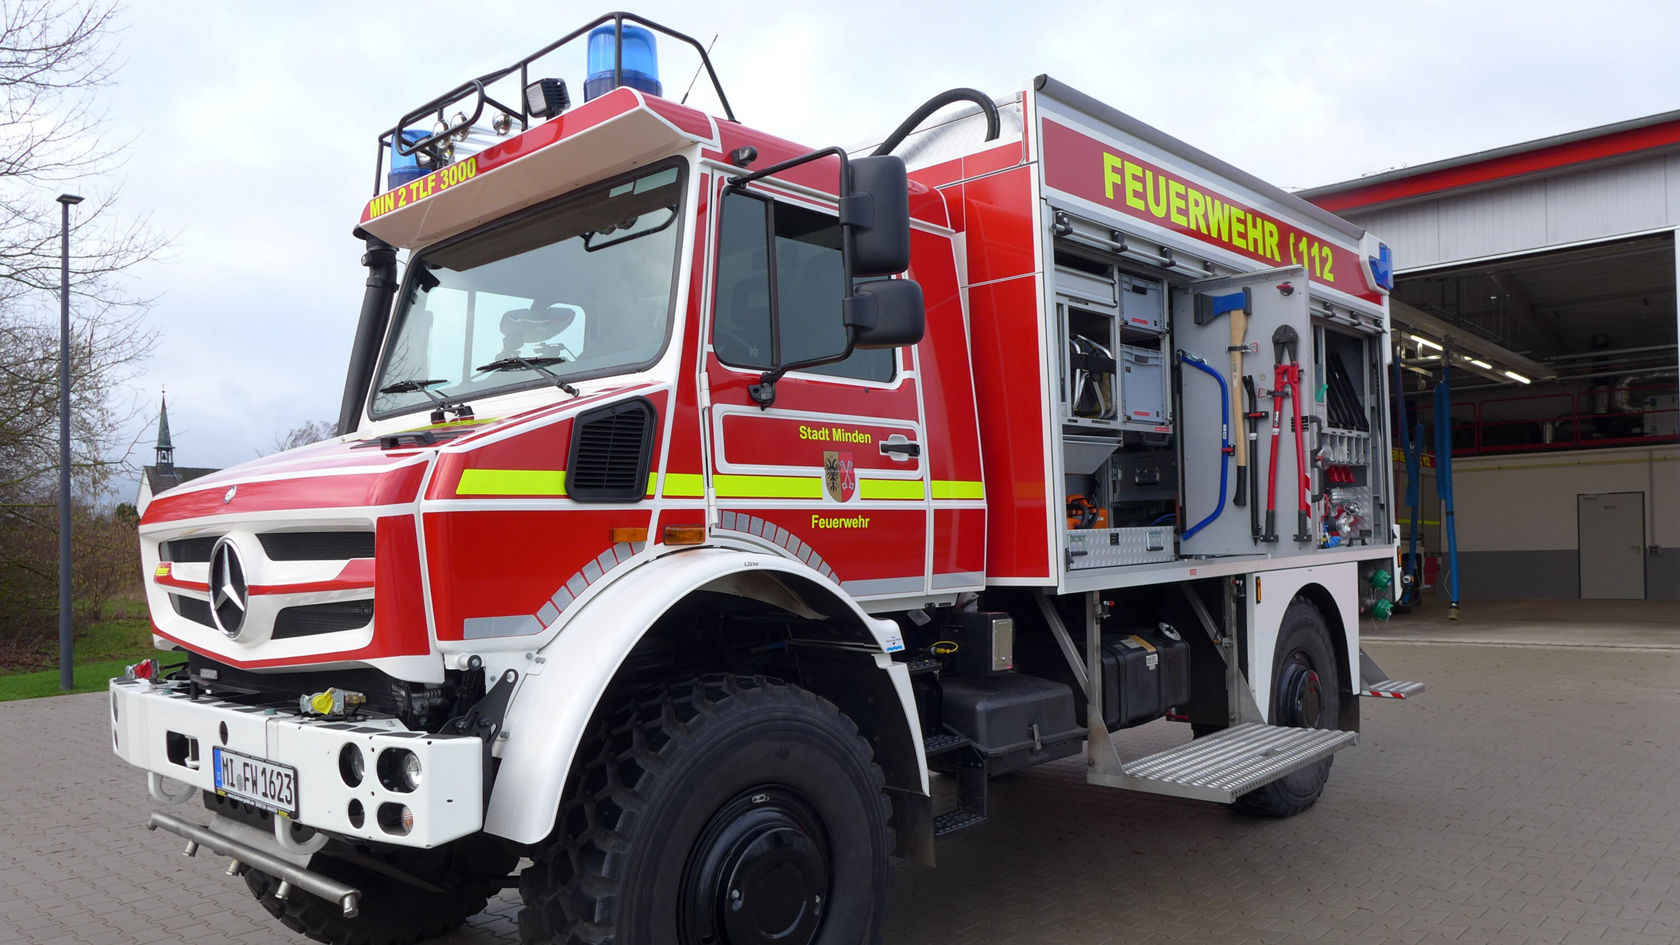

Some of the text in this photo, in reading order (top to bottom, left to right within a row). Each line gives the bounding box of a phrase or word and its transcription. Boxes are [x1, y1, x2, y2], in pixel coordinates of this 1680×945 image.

[369, 157, 477, 219] MIN 2 TLF 3000
[1103, 151, 1335, 282] FEUERWEHR 112
[799, 425, 872, 444] Stadt Minden
[811, 514, 870, 529] Feuerwehr
[222, 756, 235, 788] MI
[243, 761, 258, 795] FW
[261, 767, 292, 805] 1623
